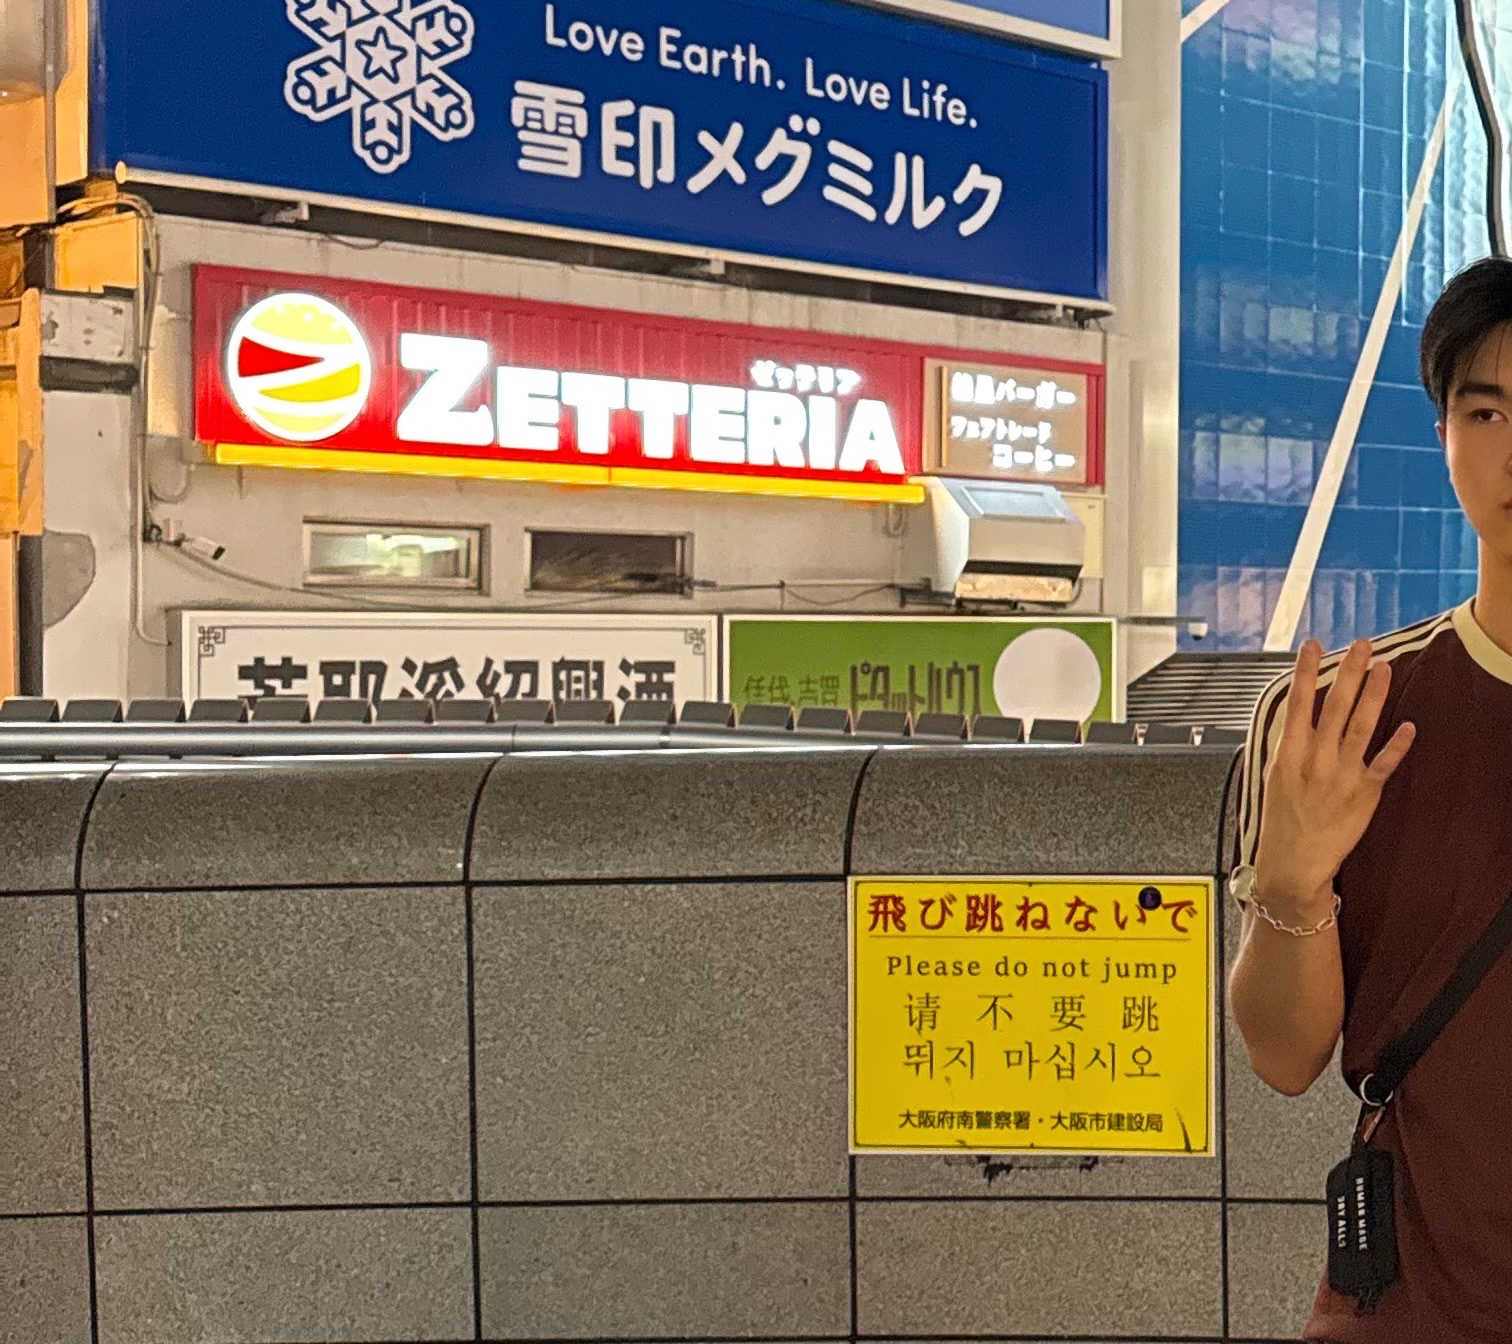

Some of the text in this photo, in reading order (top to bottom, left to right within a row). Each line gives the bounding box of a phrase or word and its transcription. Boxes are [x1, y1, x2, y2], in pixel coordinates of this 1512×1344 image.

[545, 4, 979, 131] Love Earth. Love Life.
[510, 80, 1003, 238] 雪印メグミルク
[396, 332, 905, 476] ZETTERIA
[951, 370, 1077, 410] バーガー
[992, 442, 1077, 472] コーヒー
[868, 893, 1198, 933] 飛び跳ねないで
[886, 955, 1178, 984] Please do not jump
[902, 1039, 1162, 1082] 뛰지 마십시오
